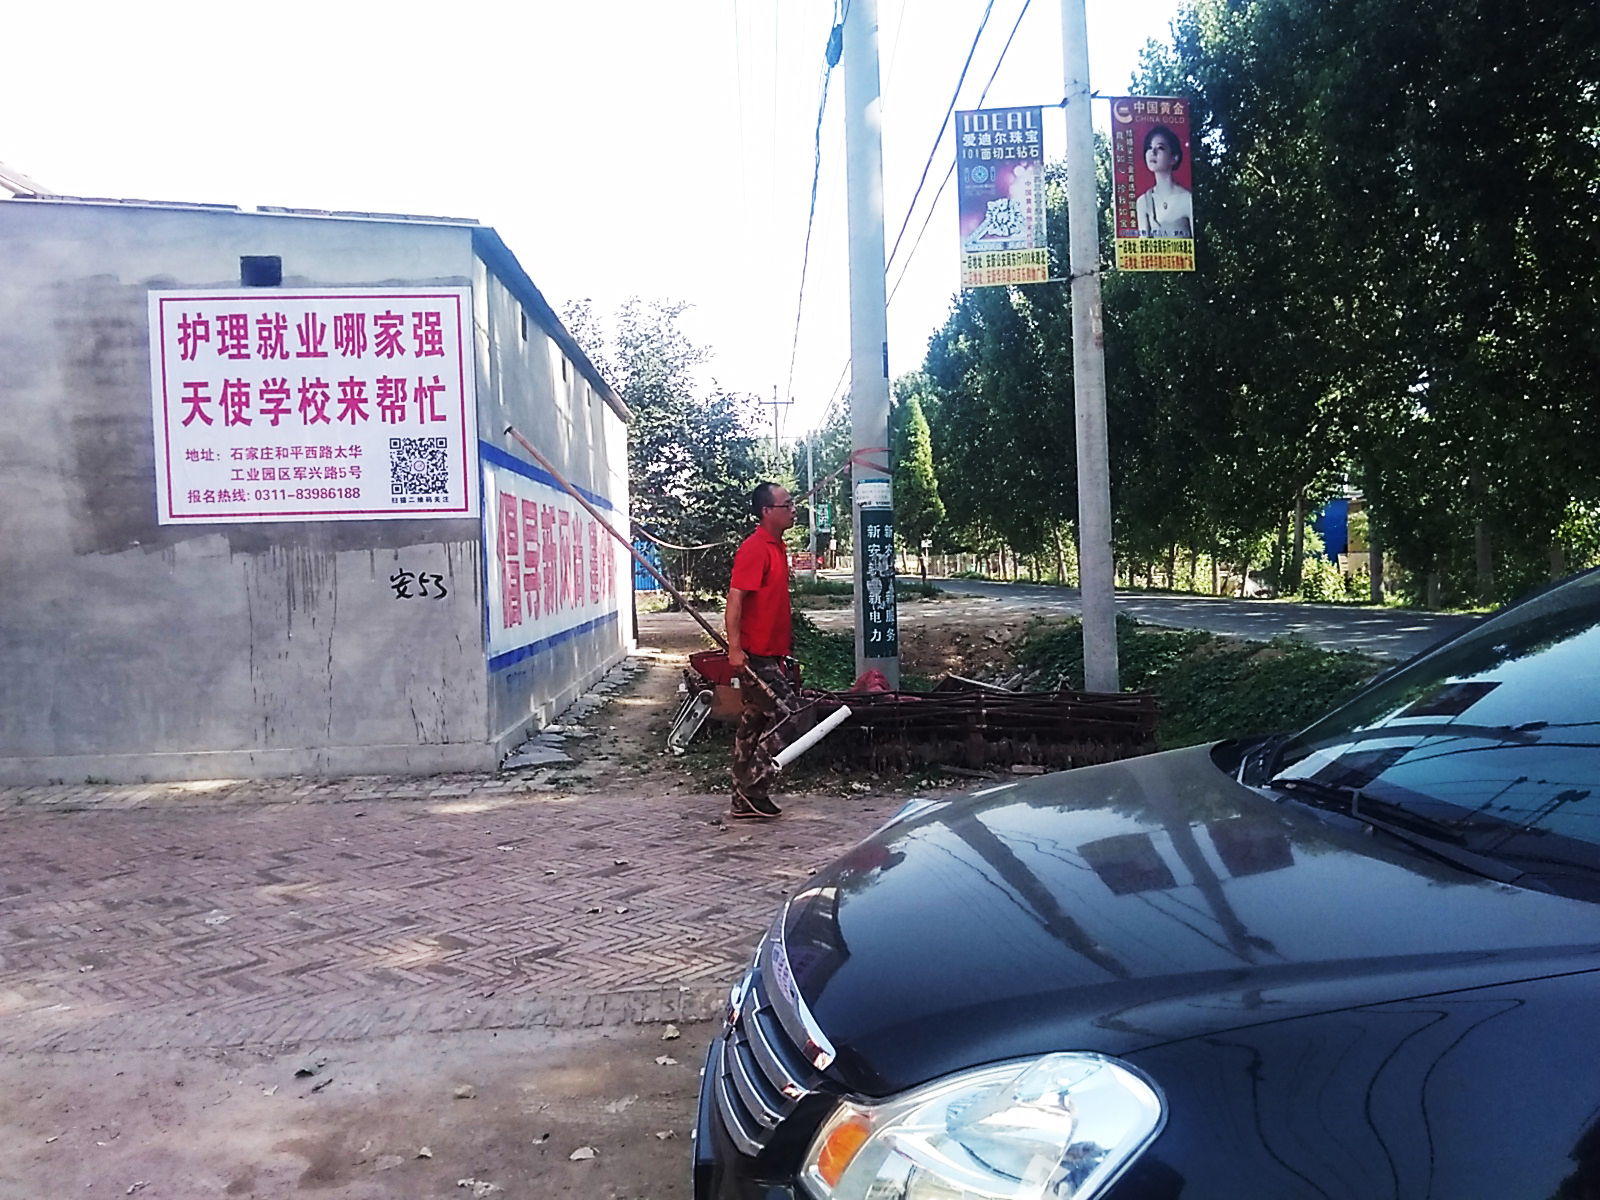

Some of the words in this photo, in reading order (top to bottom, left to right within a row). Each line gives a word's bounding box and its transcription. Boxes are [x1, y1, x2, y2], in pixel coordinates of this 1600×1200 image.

[1133, 101, 1184, 115] 中国黄金
[964, 111, 1038, 132] IDEAL
[1135, 115, 1160, 123] CHINA
[1163, 116, 1185, 124] GOLD
[963, 130, 1038, 147] 爱迪尔珠宝
[963, 145, 1039, 160] 101面切工钻石
[177, 310, 446, 362] 护理就业哪家强
[181, 375, 448, 427] 天使学校来帮忙
[231, 466, 362, 482] 工业园区军兴路5号
[391, 496, 449, 504] 扫描二维码关注
